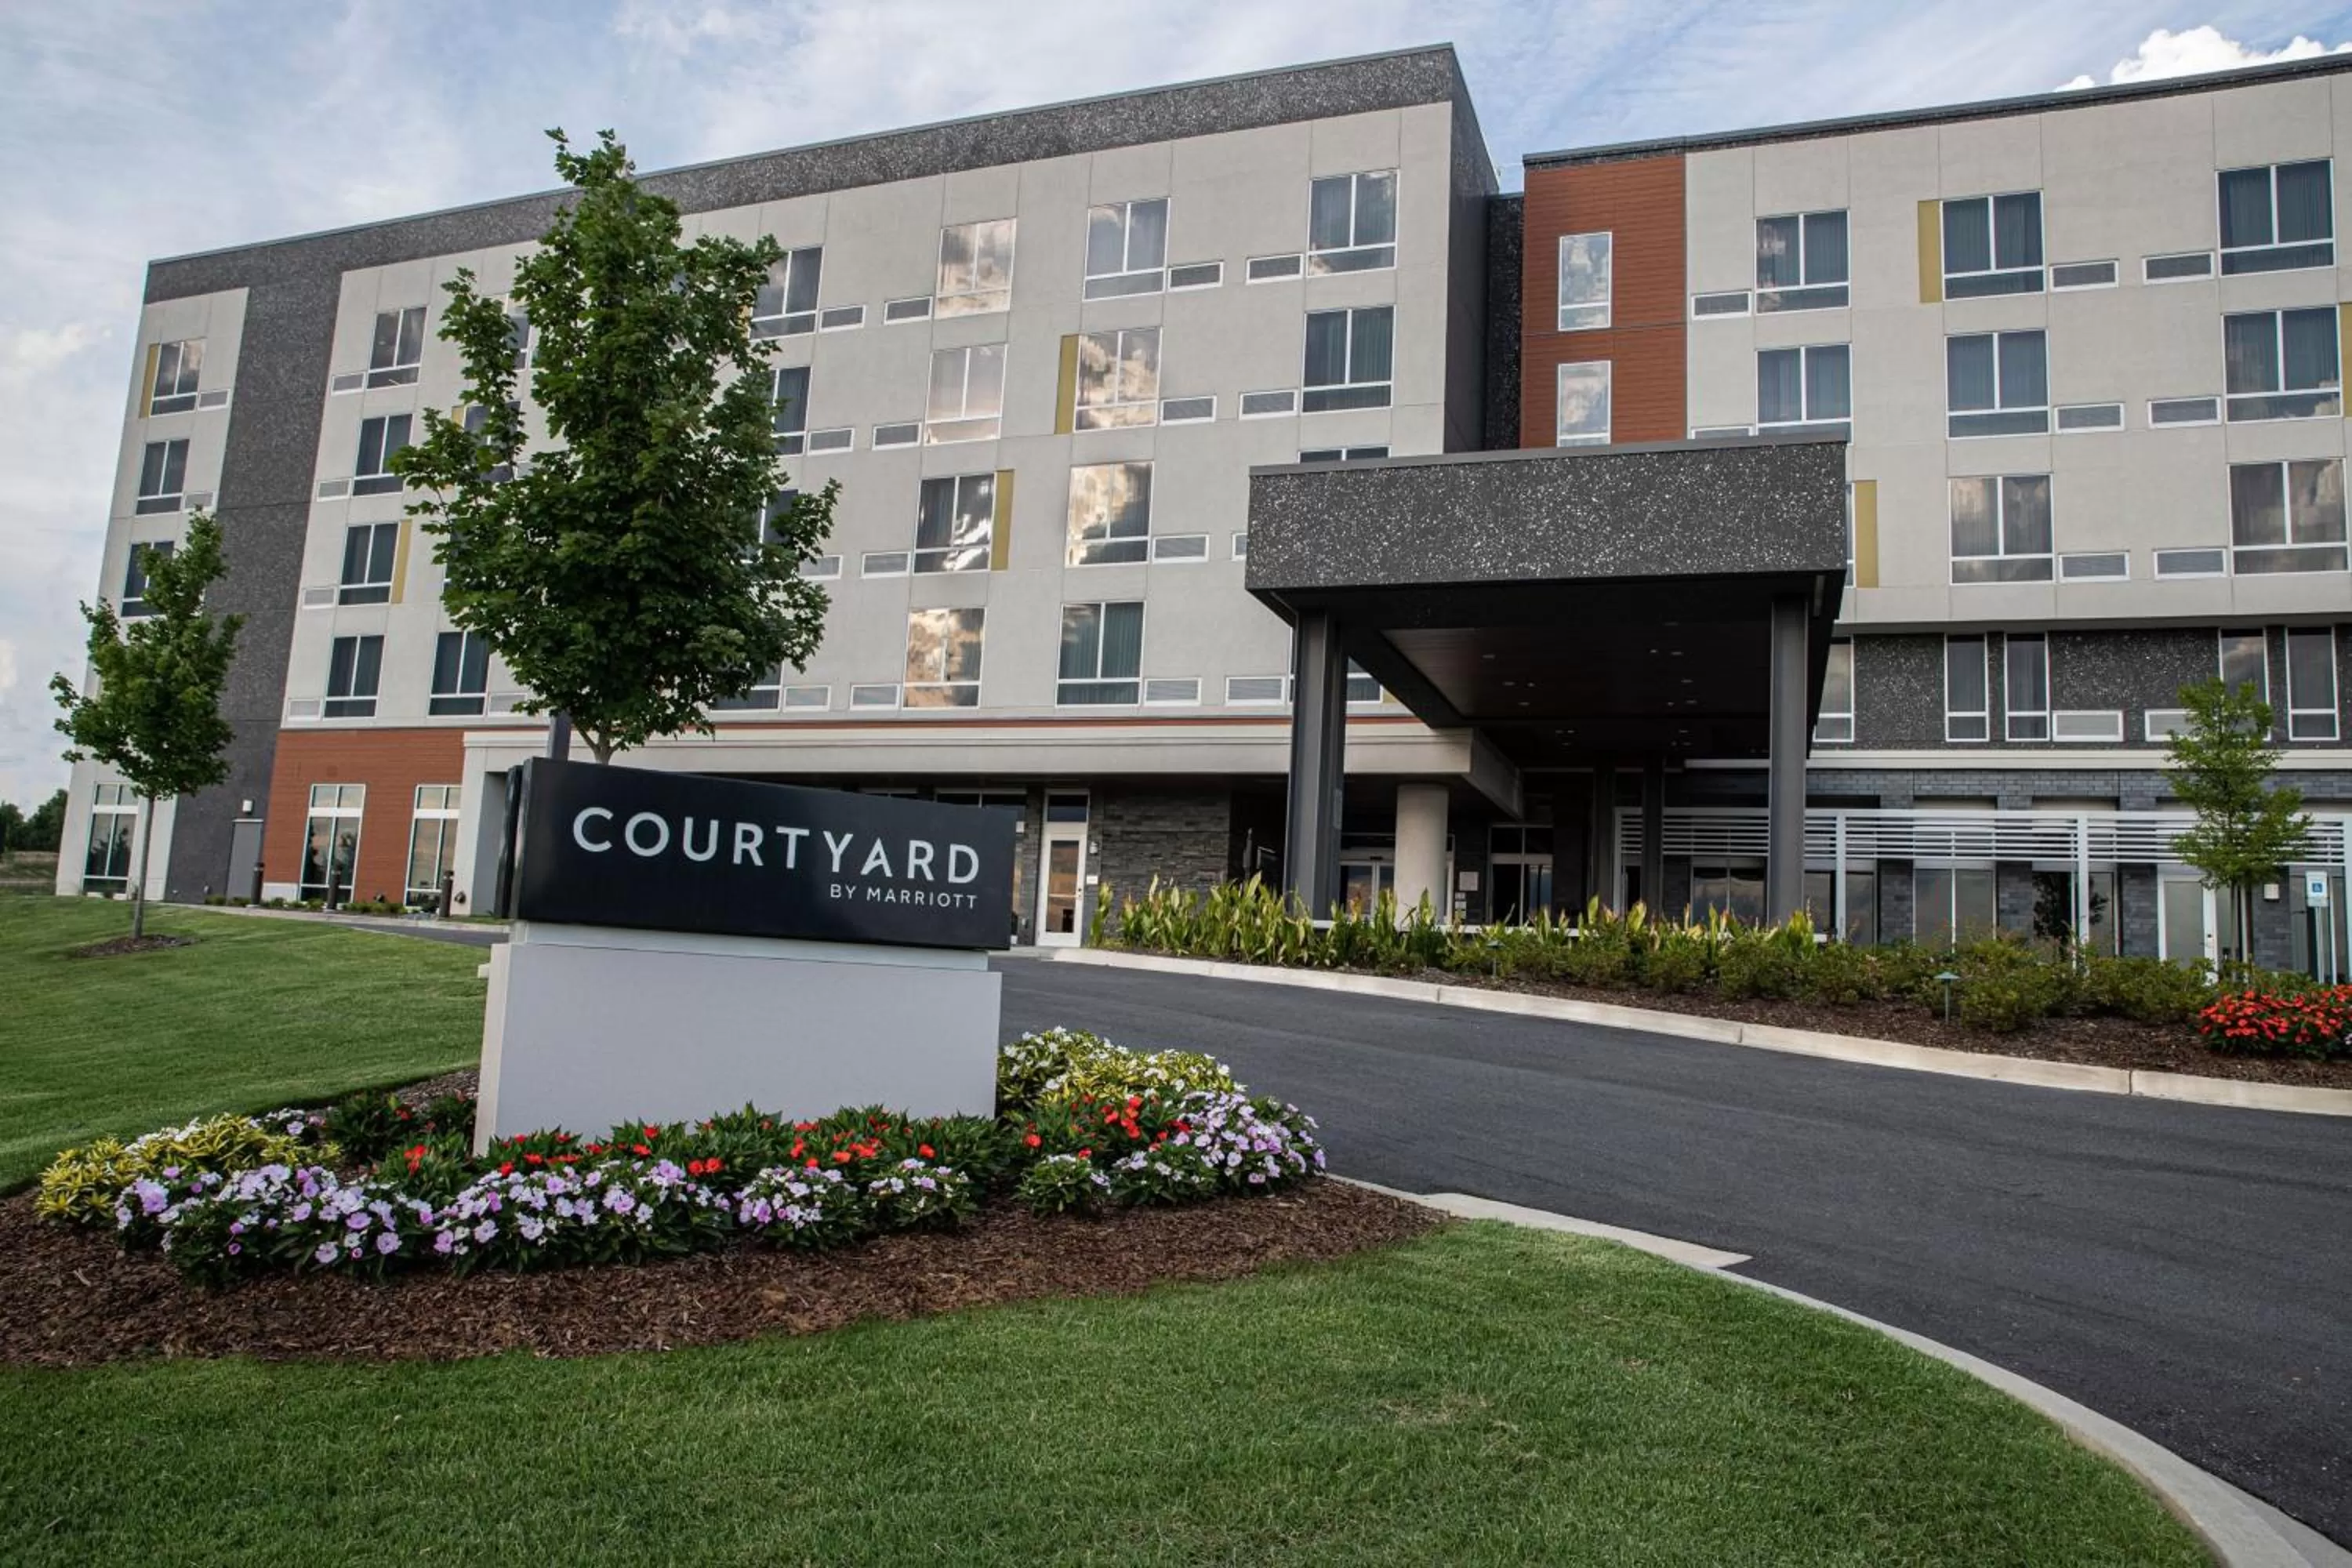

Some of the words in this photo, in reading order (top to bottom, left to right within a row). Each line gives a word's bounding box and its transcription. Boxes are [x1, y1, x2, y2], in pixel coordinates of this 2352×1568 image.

[573, 807, 980, 884] COURTYARD
[829, 884, 856, 899] BY
[866, 887, 977, 909] MARRIOTT
